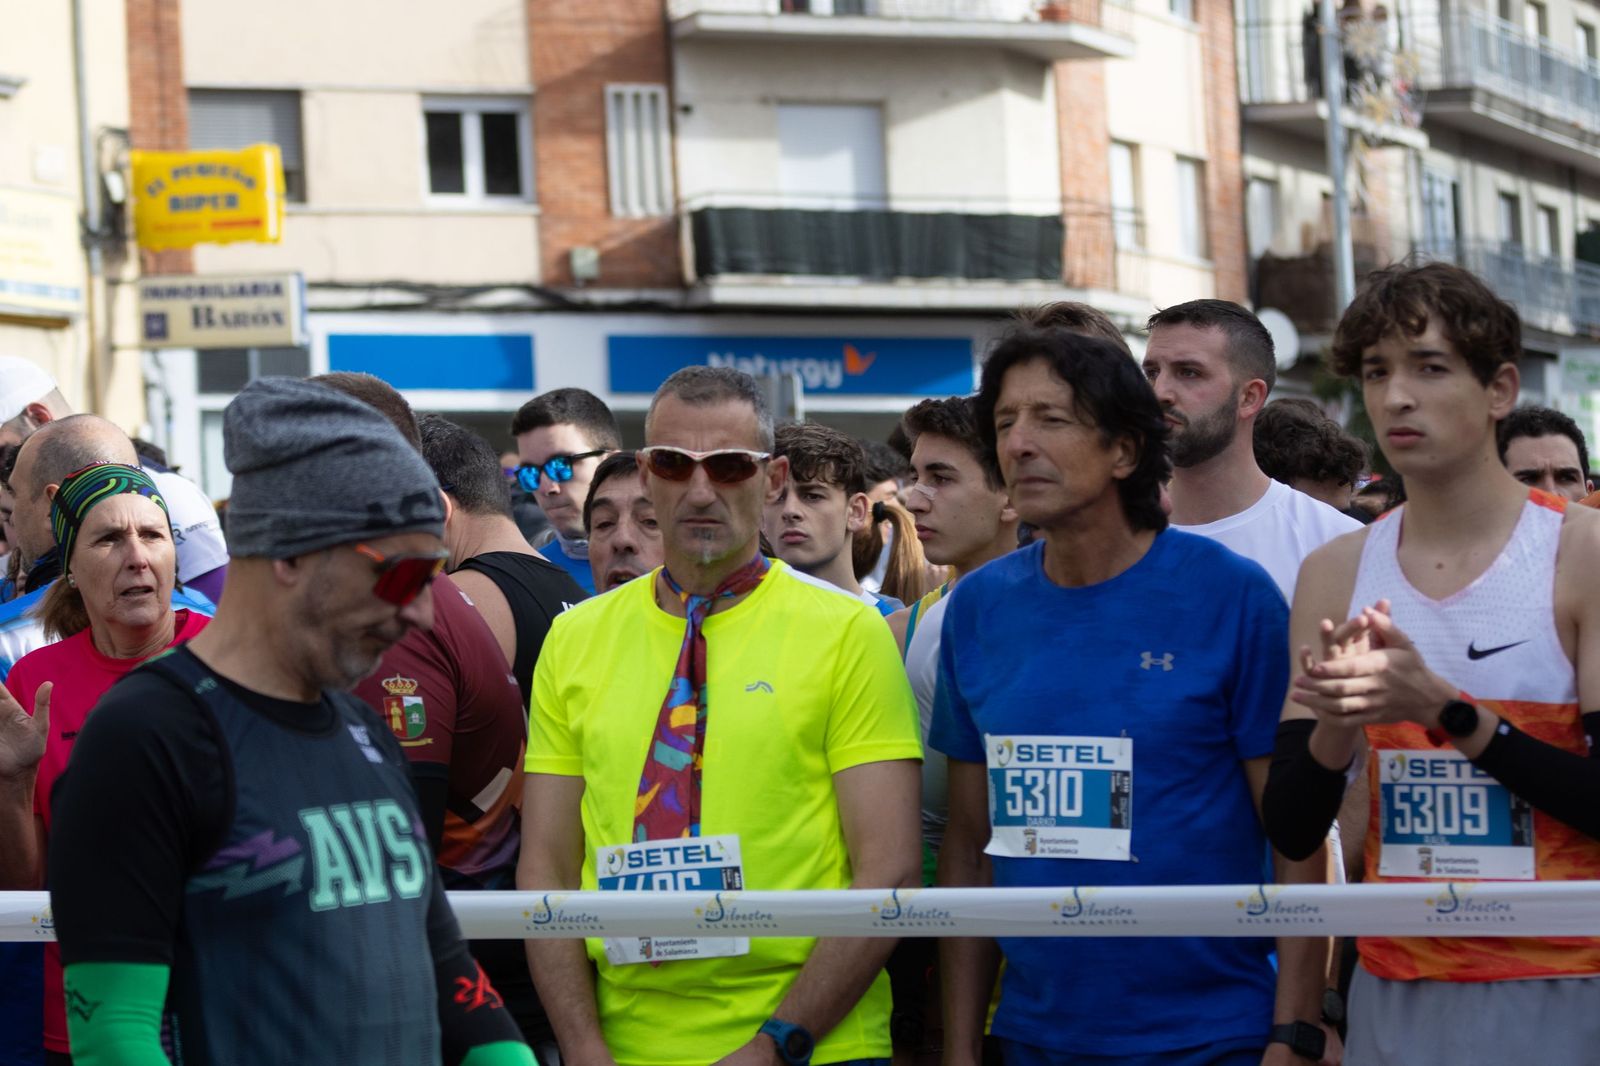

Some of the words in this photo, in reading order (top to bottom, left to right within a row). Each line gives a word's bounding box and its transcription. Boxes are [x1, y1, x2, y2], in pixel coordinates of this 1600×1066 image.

[1016, 744, 1115, 765] SETEL
[1408, 758, 1490, 778] SETE
[1005, 769, 1083, 817] 5310
[1393, 785, 1489, 836] 5309
[298, 799, 425, 912] AVS
[627, 844, 723, 869] SETEL
